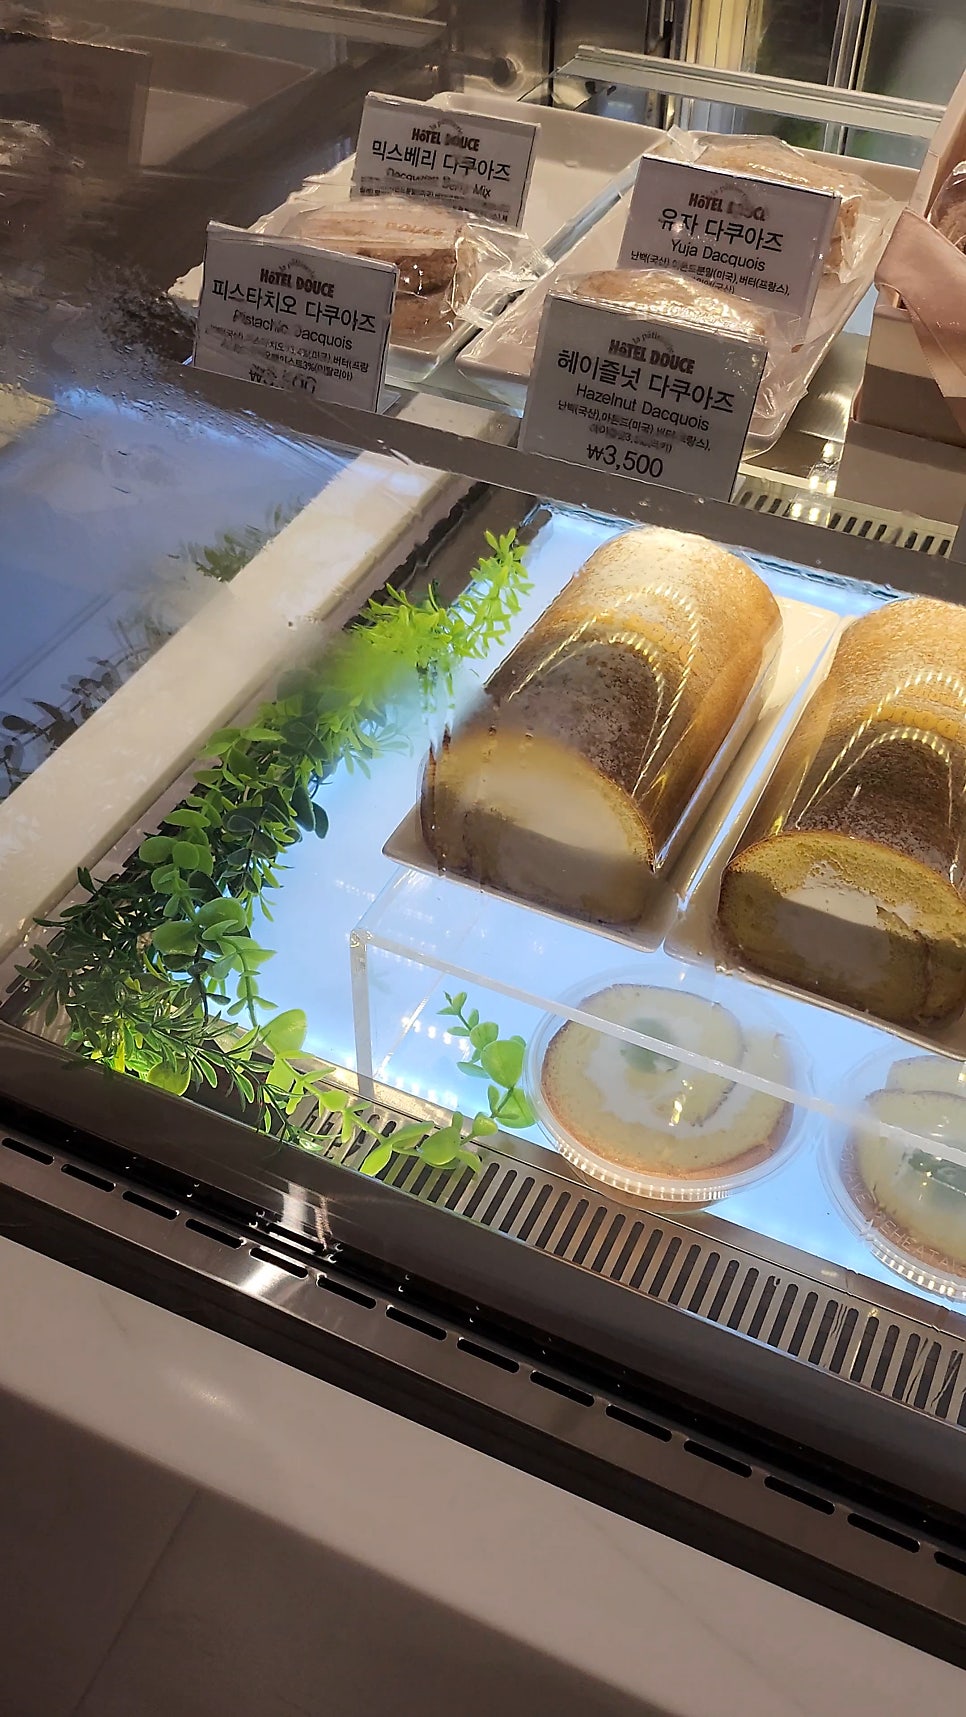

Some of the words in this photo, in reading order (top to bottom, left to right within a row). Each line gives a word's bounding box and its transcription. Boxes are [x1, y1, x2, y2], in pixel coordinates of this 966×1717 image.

[372, 140, 437, 170] 믹스베리
[472, 183, 492, 200] Mix
[658, 207, 698, 236] 유자
[704, 219, 784, 253] 다쿠아즈
[671, 239, 698, 257] Yuja
[702, 246, 766, 272] Dacquois
[296, 276, 335, 298] DOUCE
[211, 279, 297, 316] 피스타치오
[305, 301, 377, 334] 다쿠아즈
[649, 350, 696, 375] DOUCE
[557, 349, 642, 391] 헤이즐넛
[649, 374, 735, 413] 다쿠아즈
[576, 383, 637, 412] Hazelnut
[642, 401, 709, 431] Dacquois
[587, 443, 664, 478] ₩3,500
